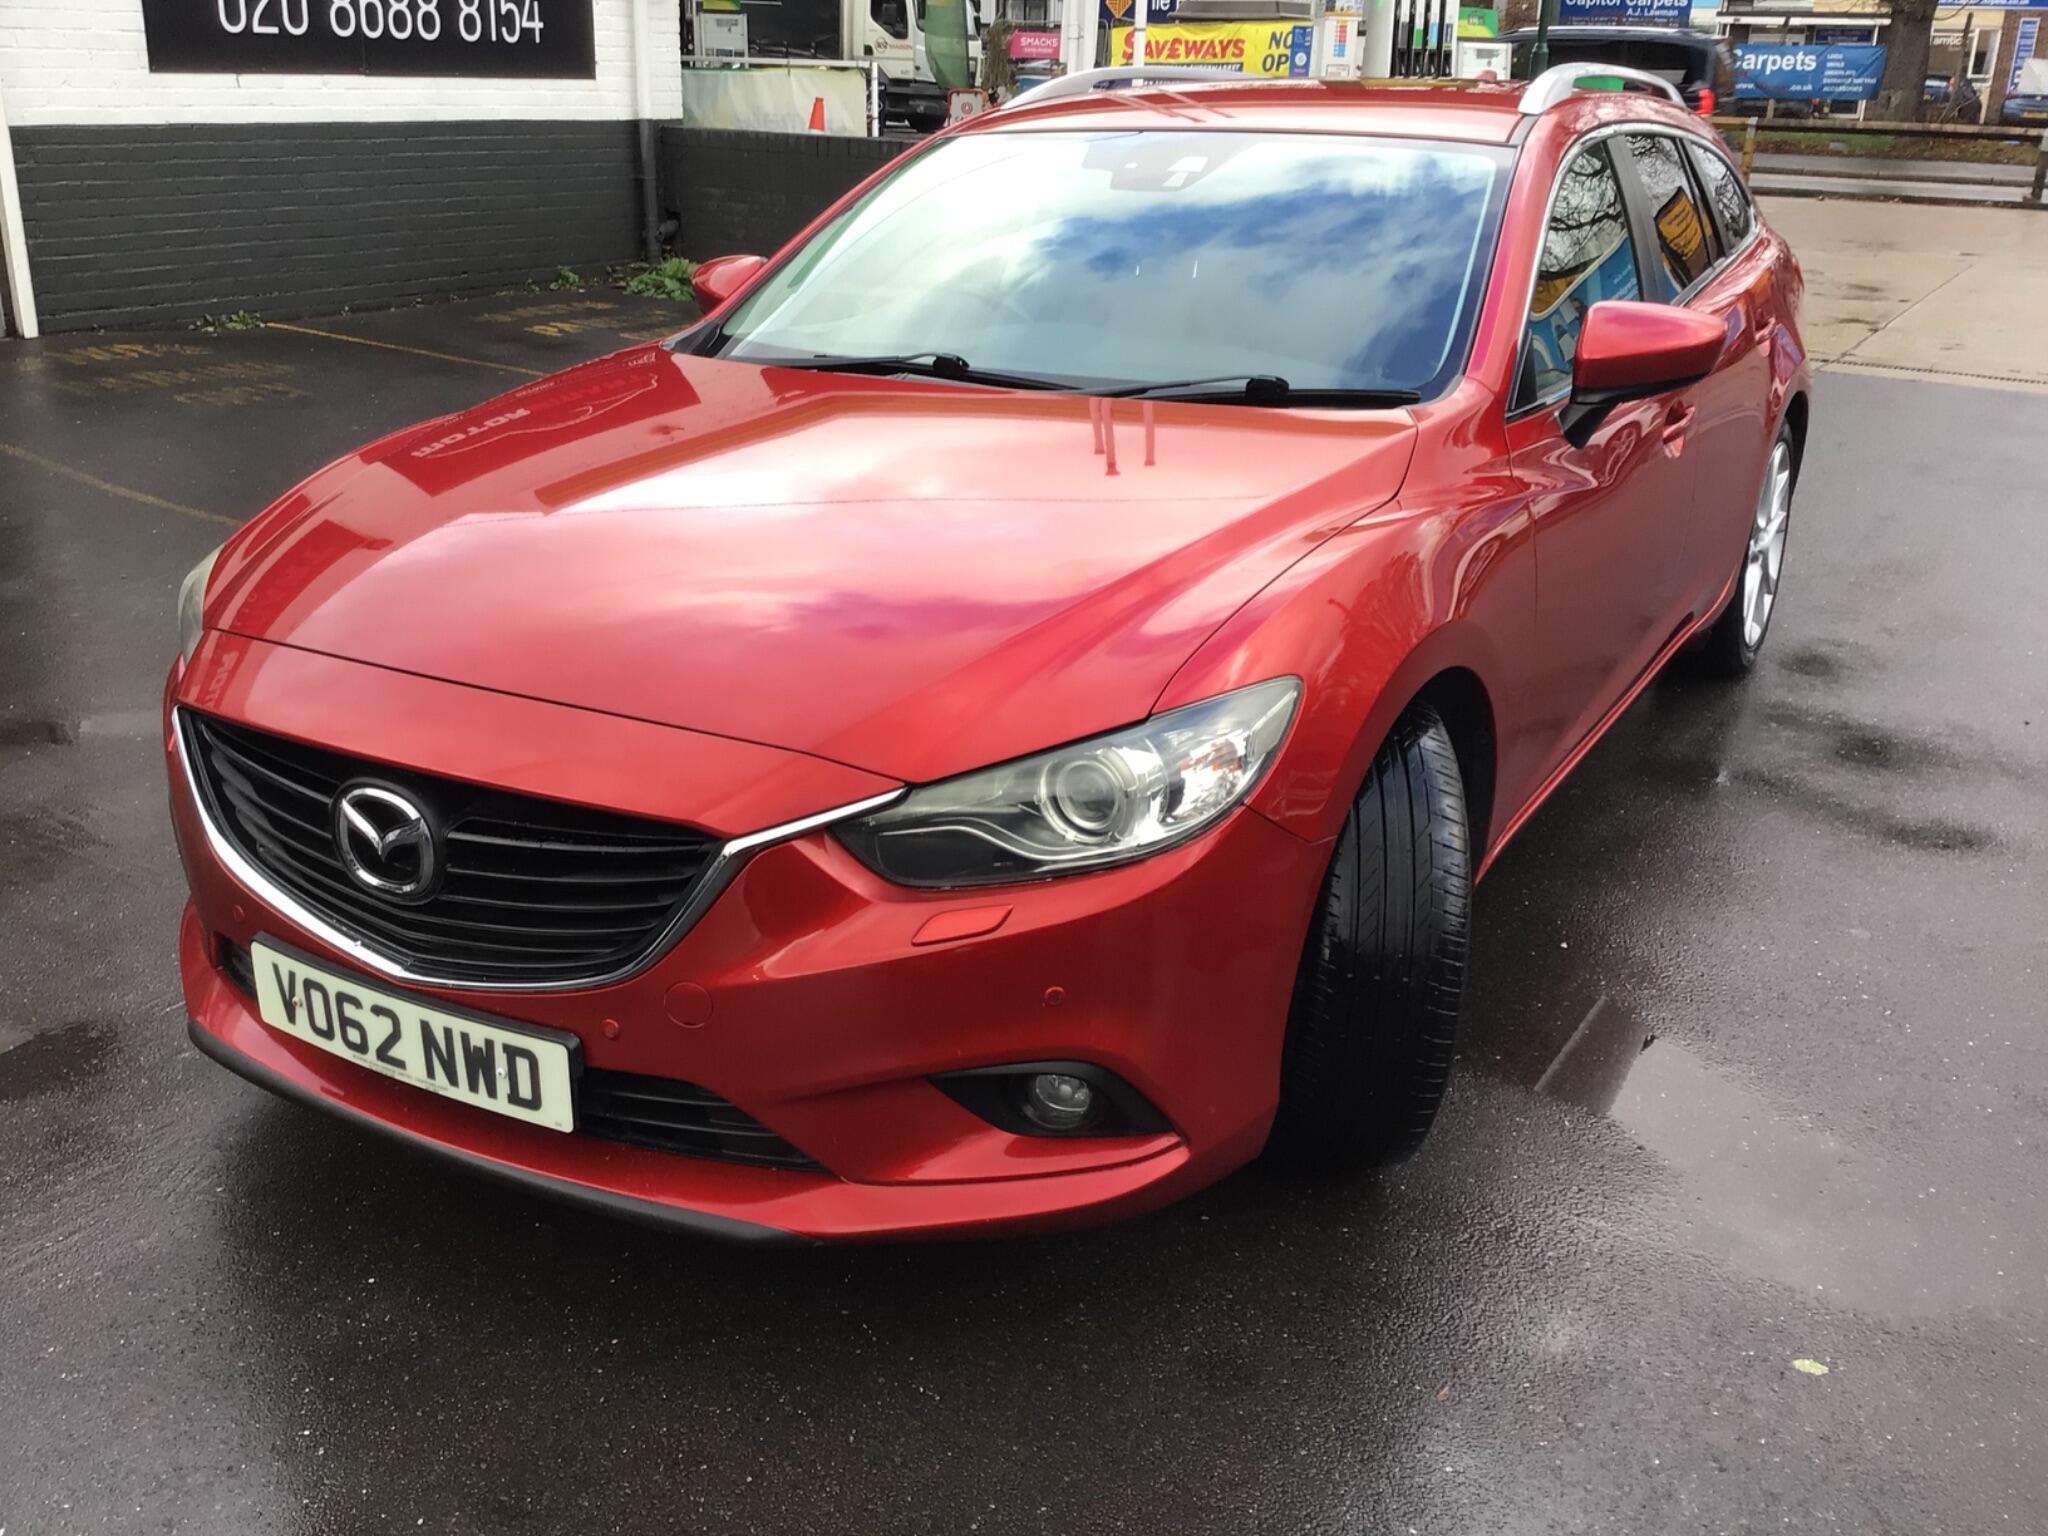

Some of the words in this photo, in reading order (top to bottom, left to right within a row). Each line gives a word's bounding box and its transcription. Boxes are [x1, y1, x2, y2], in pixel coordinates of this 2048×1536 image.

[329, 0, 441, 41] 8688
[458, 0, 544, 43] 8154
[1020, 37, 1058, 48] SMACKS
[272, 962, 407, 1070] VO62
[419, 1019, 542, 1111] NWD
